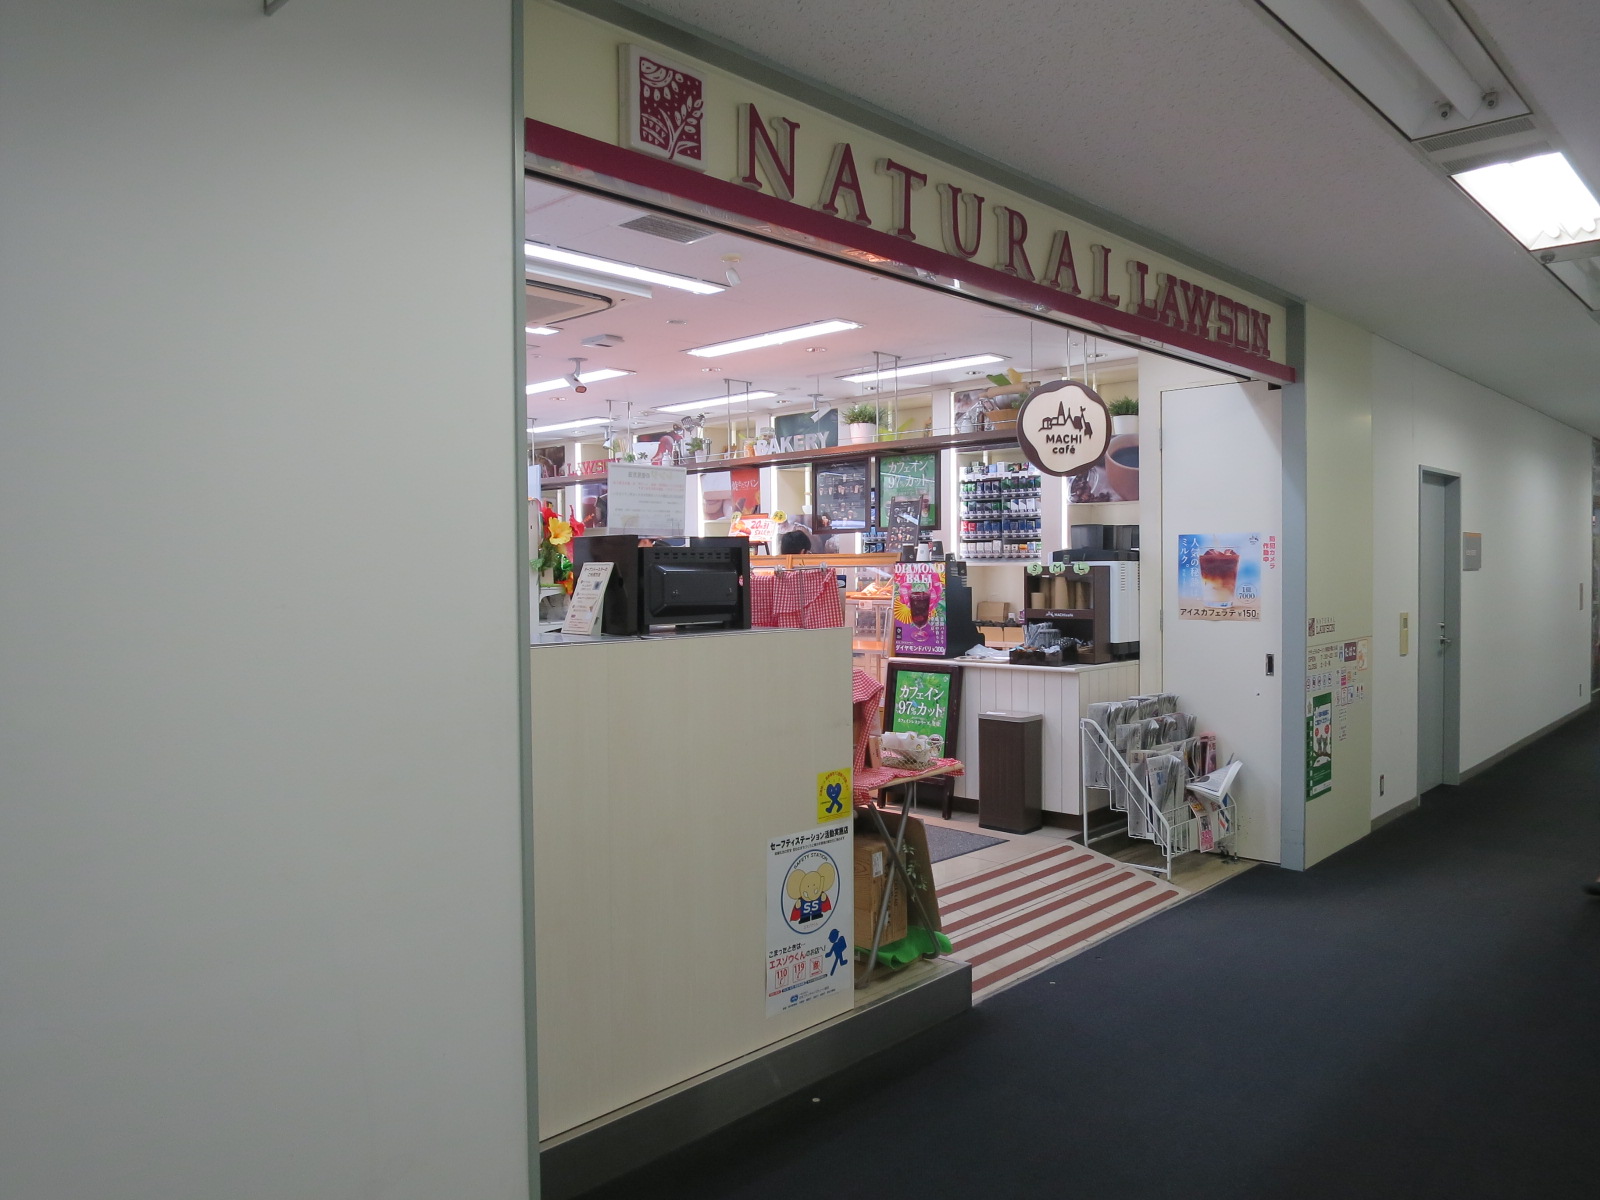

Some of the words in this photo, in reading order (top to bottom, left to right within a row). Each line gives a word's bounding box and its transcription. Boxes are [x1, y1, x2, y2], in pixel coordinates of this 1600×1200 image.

[732, 103, 1120, 308] NATURAL
[1127, 260, 1272, 359] LAWSON
[756, 431, 830, 456] BAKERY
[1046, 434, 1082, 444] MACHI
[1052, 444, 1076, 454] café
[1180, 538, 1190, 568] ミルク。
[895, 563, 946, 574] DIAMOND
[1032, 564, 1038, 572] S
[1053, 564, 1062, 572] M
[1077, 563, 1085, 571] L
[906, 574, 932, 584] BALI
[1239, 592, 1256, 600] 7000
[1180, 608, 1236, 617] アイスカフェラテ
[895, 645, 932, 653] ダイヤモンドバリ
[1344, 646, 1356, 657] たばこ
[900, 684, 945, 701] カフェイン
[793, 853, 811, 870] SAFETY
[810, 851, 829, 862] STATION
[803, 900, 819, 914] SS
[776, 967, 788, 979] 110
[794, 963, 805, 974] 119
